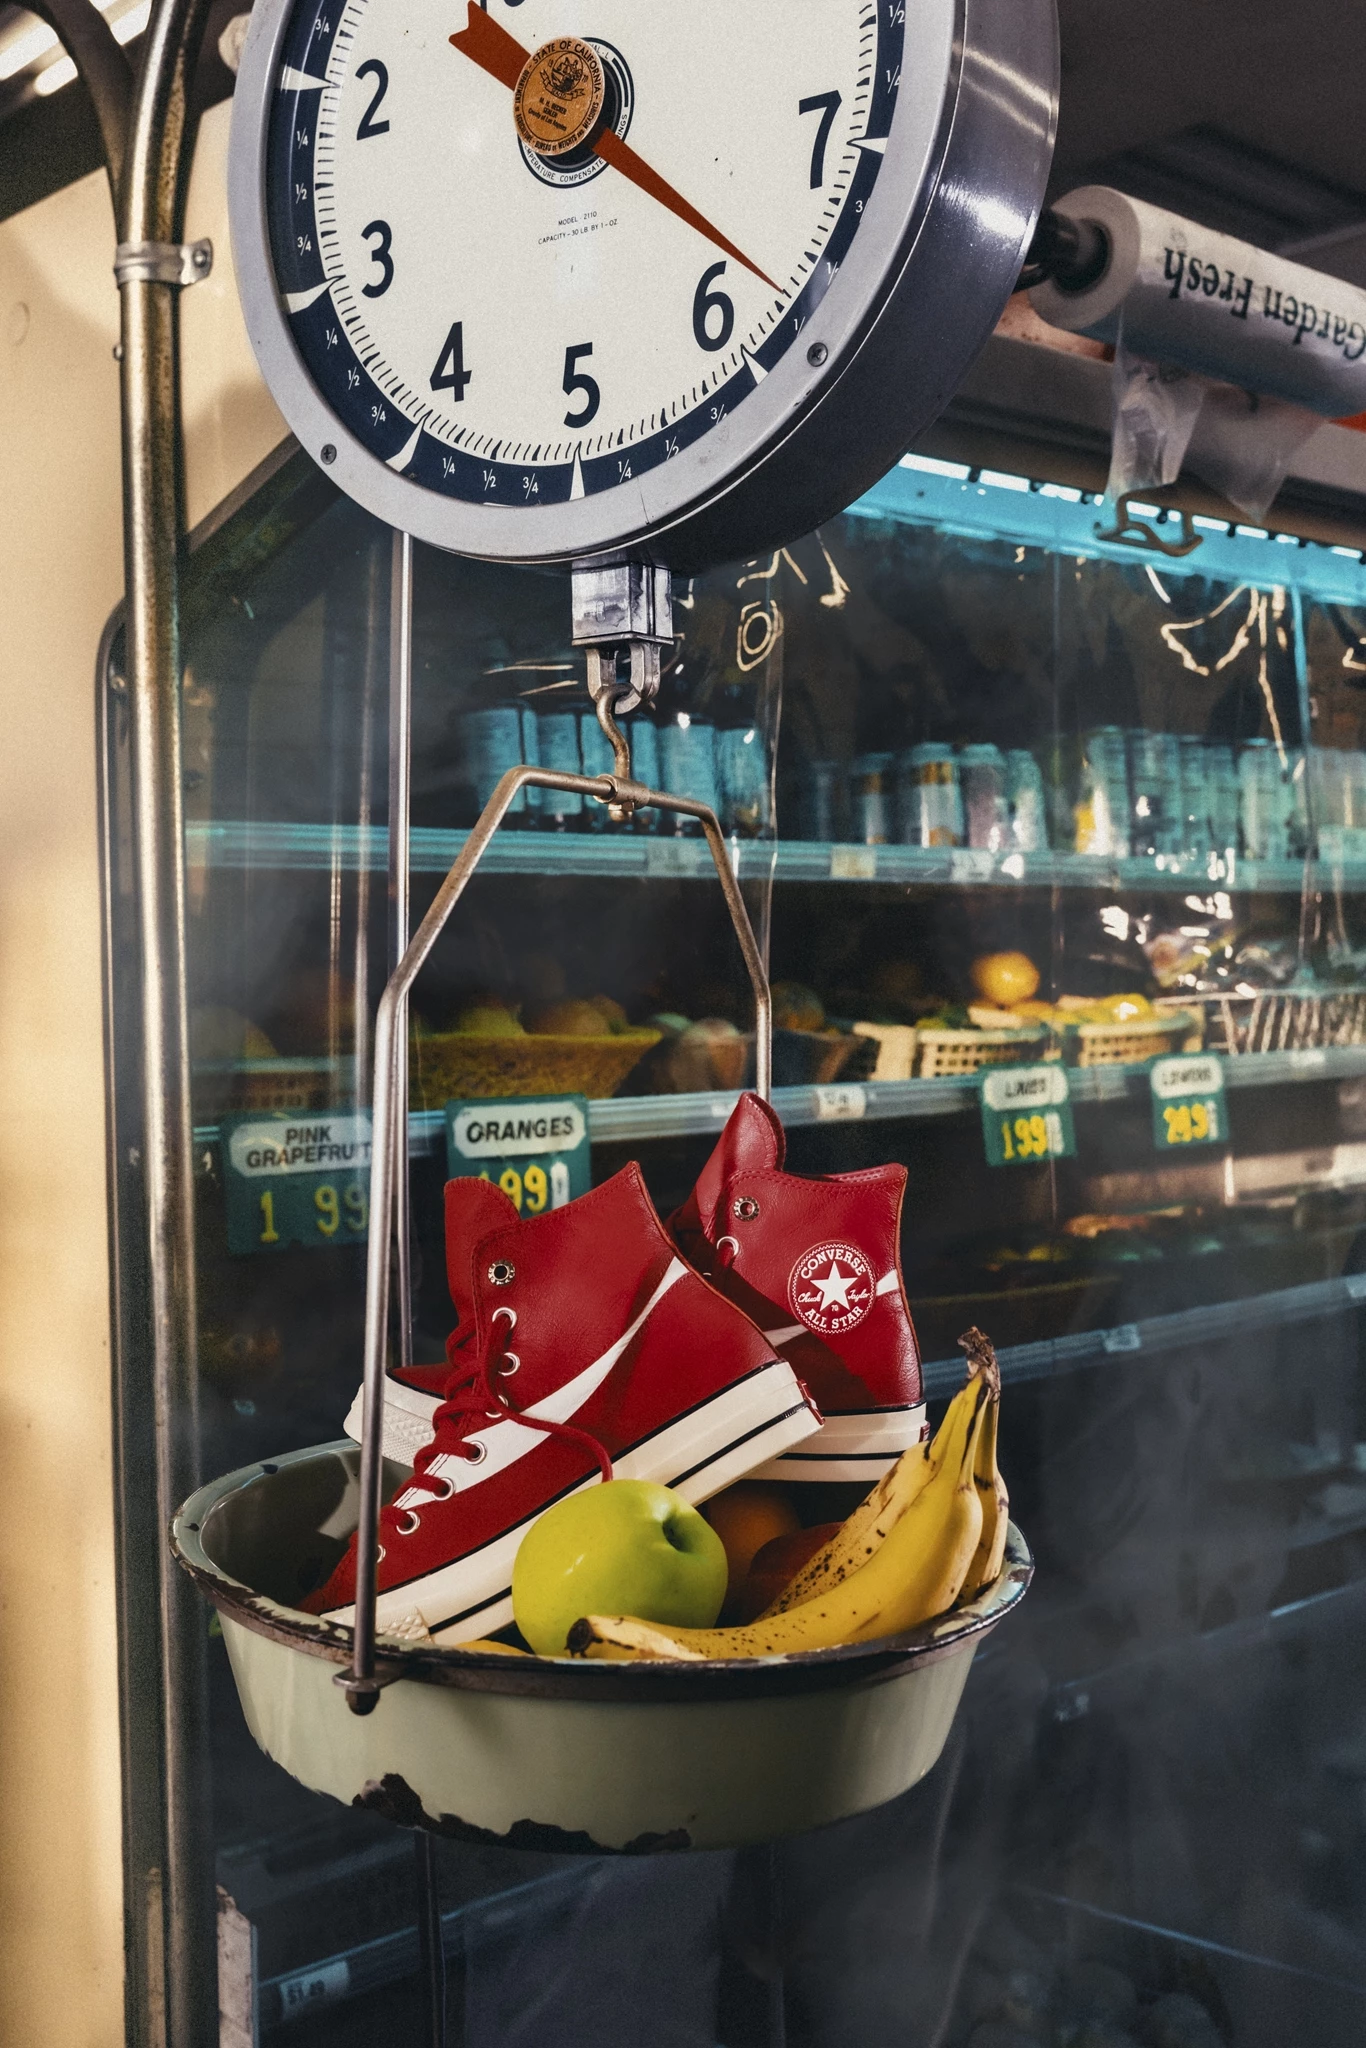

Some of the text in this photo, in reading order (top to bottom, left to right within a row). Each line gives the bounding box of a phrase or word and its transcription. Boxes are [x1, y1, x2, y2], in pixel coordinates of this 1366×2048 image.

[314, 16, 330, 40] 3/4
[532, 40, 600, 93] STATE OF CALIFORNIA
[355, 58, 390, 141] 2
[558, 134, 577, 149] WEIGHTS
[582, 102, 599, 129] MEASURES
[296, 128, 308, 150] 1/4
[798, 90, 842, 190] 7
[295, 183, 307, 204] 1/2
[558, 211, 598, 226] MODEL 2110
[590, 224, 598, 232] BY
[297, 234, 312, 256] 3/4
[360, 219, 394, 298] 3
[692, 260, 734, 352] 6
[1164, 247, 1366, 361] Garden Fresh
[326, 328, 338, 350] 1/4
[429, 321, 472, 402] 4
[348, 366, 360, 390] 1/2
[562, 342, 600, 429] 5
[371, 404, 386, 426] 3/4
[442, 456, 456, 479] 1/4
[482, 468, 496, 491] 1/2
[618, 459, 632, 484] 1/4
[522, 473, 538, 500] 3/4
[286, 1125, 332, 1146] PINK
[466, 1116, 574, 1144] ORANGES
[800, 1248, 866, 1279] CONVERSE
[798, 1289, 870, 1303] Chuck Taylor
[804, 1306, 864, 1329] ALL STAR
